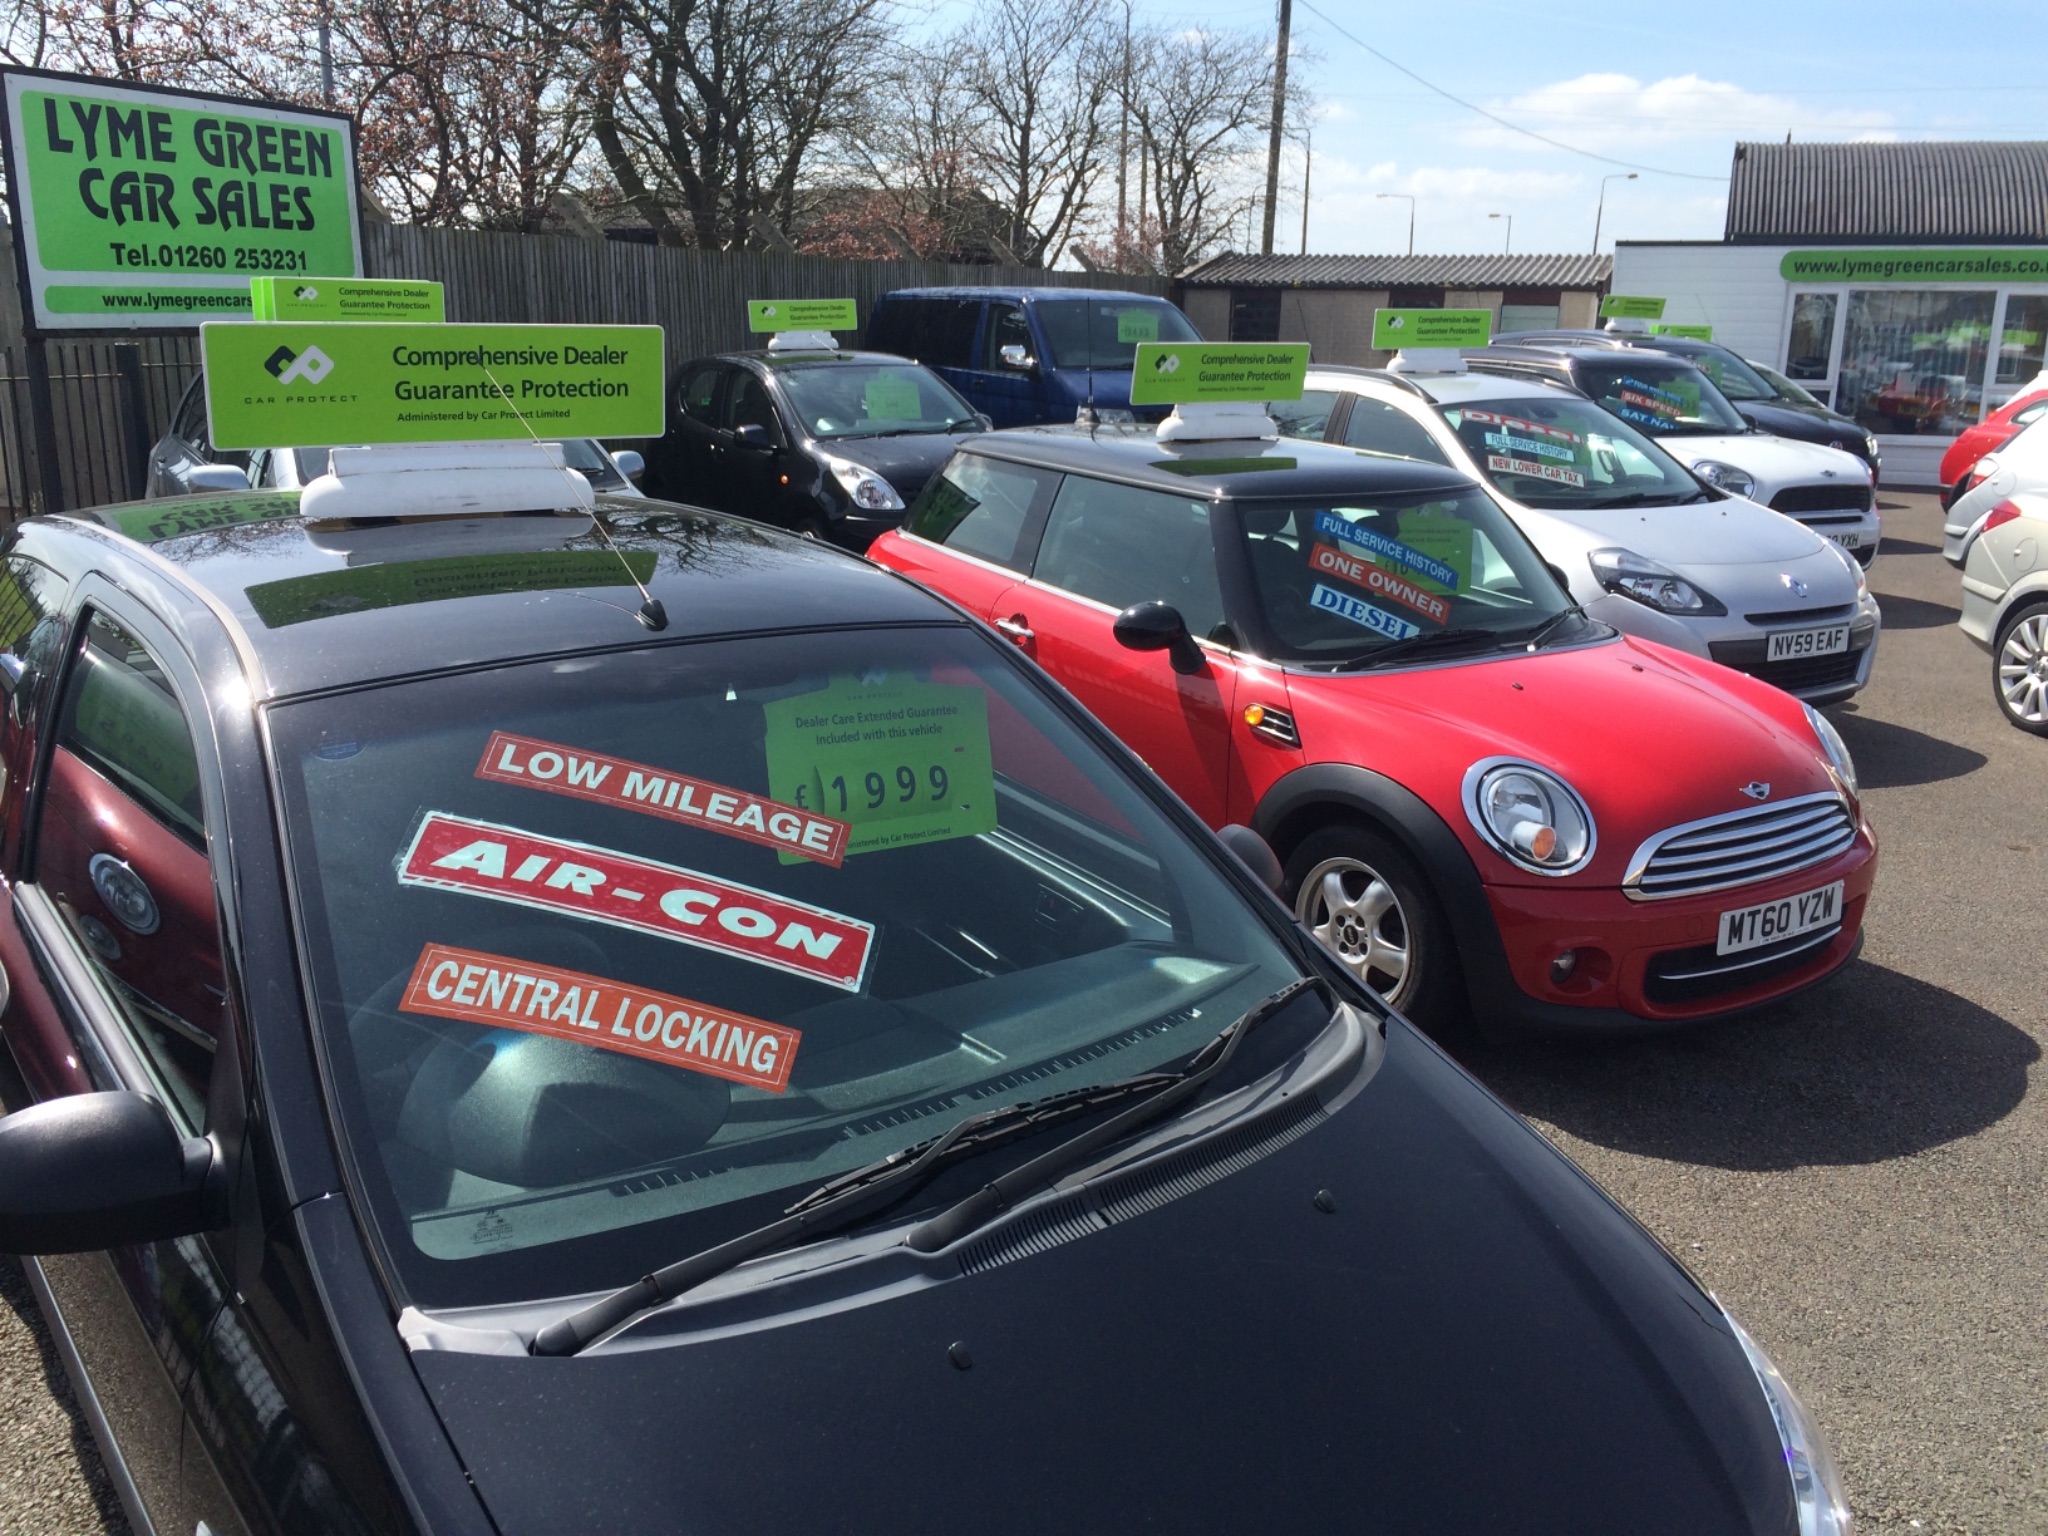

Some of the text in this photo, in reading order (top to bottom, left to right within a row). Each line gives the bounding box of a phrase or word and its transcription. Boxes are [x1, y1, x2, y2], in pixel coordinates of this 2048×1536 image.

[43, 97, 332, 177] LYME GREEN
[79, 168, 315, 232] CAR SALES
[110, 242, 307, 271] Tel.01260 253231
[339, 287, 429, 297] Comprehensive Dealer
[339, 300, 430, 310] Guarantee Protection
[1416, 327, 1448, 335] Guarantee
[1449, 327, 1480, 335] Protection
[1418, 316, 1481, 325] Comprehensive Dealer
[392, 345, 629, 371] Comprehensive Dealer
[1201, 354, 1294, 367] Comprehensive Dealer
[1199, 371, 1245, 382] Guarantee
[1246, 370, 1291, 382] Protection
[244, 394, 358, 405] CAR PROTECT
[394, 378, 629, 401] Guarantee Protection
[397, 408, 571, 422] Administered by Car Protect Limited
[1621, 408, 1648, 421] SAT
[1624, 391, 1641, 404] SIX
[1645, 398, 1681, 417] SPEED
[1491, 433, 1568, 458] FULL SERVICE HISTORY
[1492, 457, 1579, 484] NEW LOWER CAR TAX
[1322, 516, 1452, 583] FULL SERVICE HISTORY
[1841, 534, 1859, 547] YXH
[1319, 552, 1443, 617] ONE OWNER
[1773, 629, 1843, 657] NV59 EAF
[795, 706, 958, 729] Dealer Care Extended Guarantee
[816, 723, 942, 745] Included with this vehicle
[498, 743, 834, 852] LOW MILEAGE
[881, 836, 889, 845] by
[890, 834, 902, 842] Car
[903, 831, 926, 840] Protect
[927, 827, 951, 837] Limited
[430, 839, 843, 960] AIR-CON
[1727, 902, 1791, 946] MT60
[1798, 887, 1835, 927] YZW
[426, 960, 780, 1074] CENTRAL LOCKING
